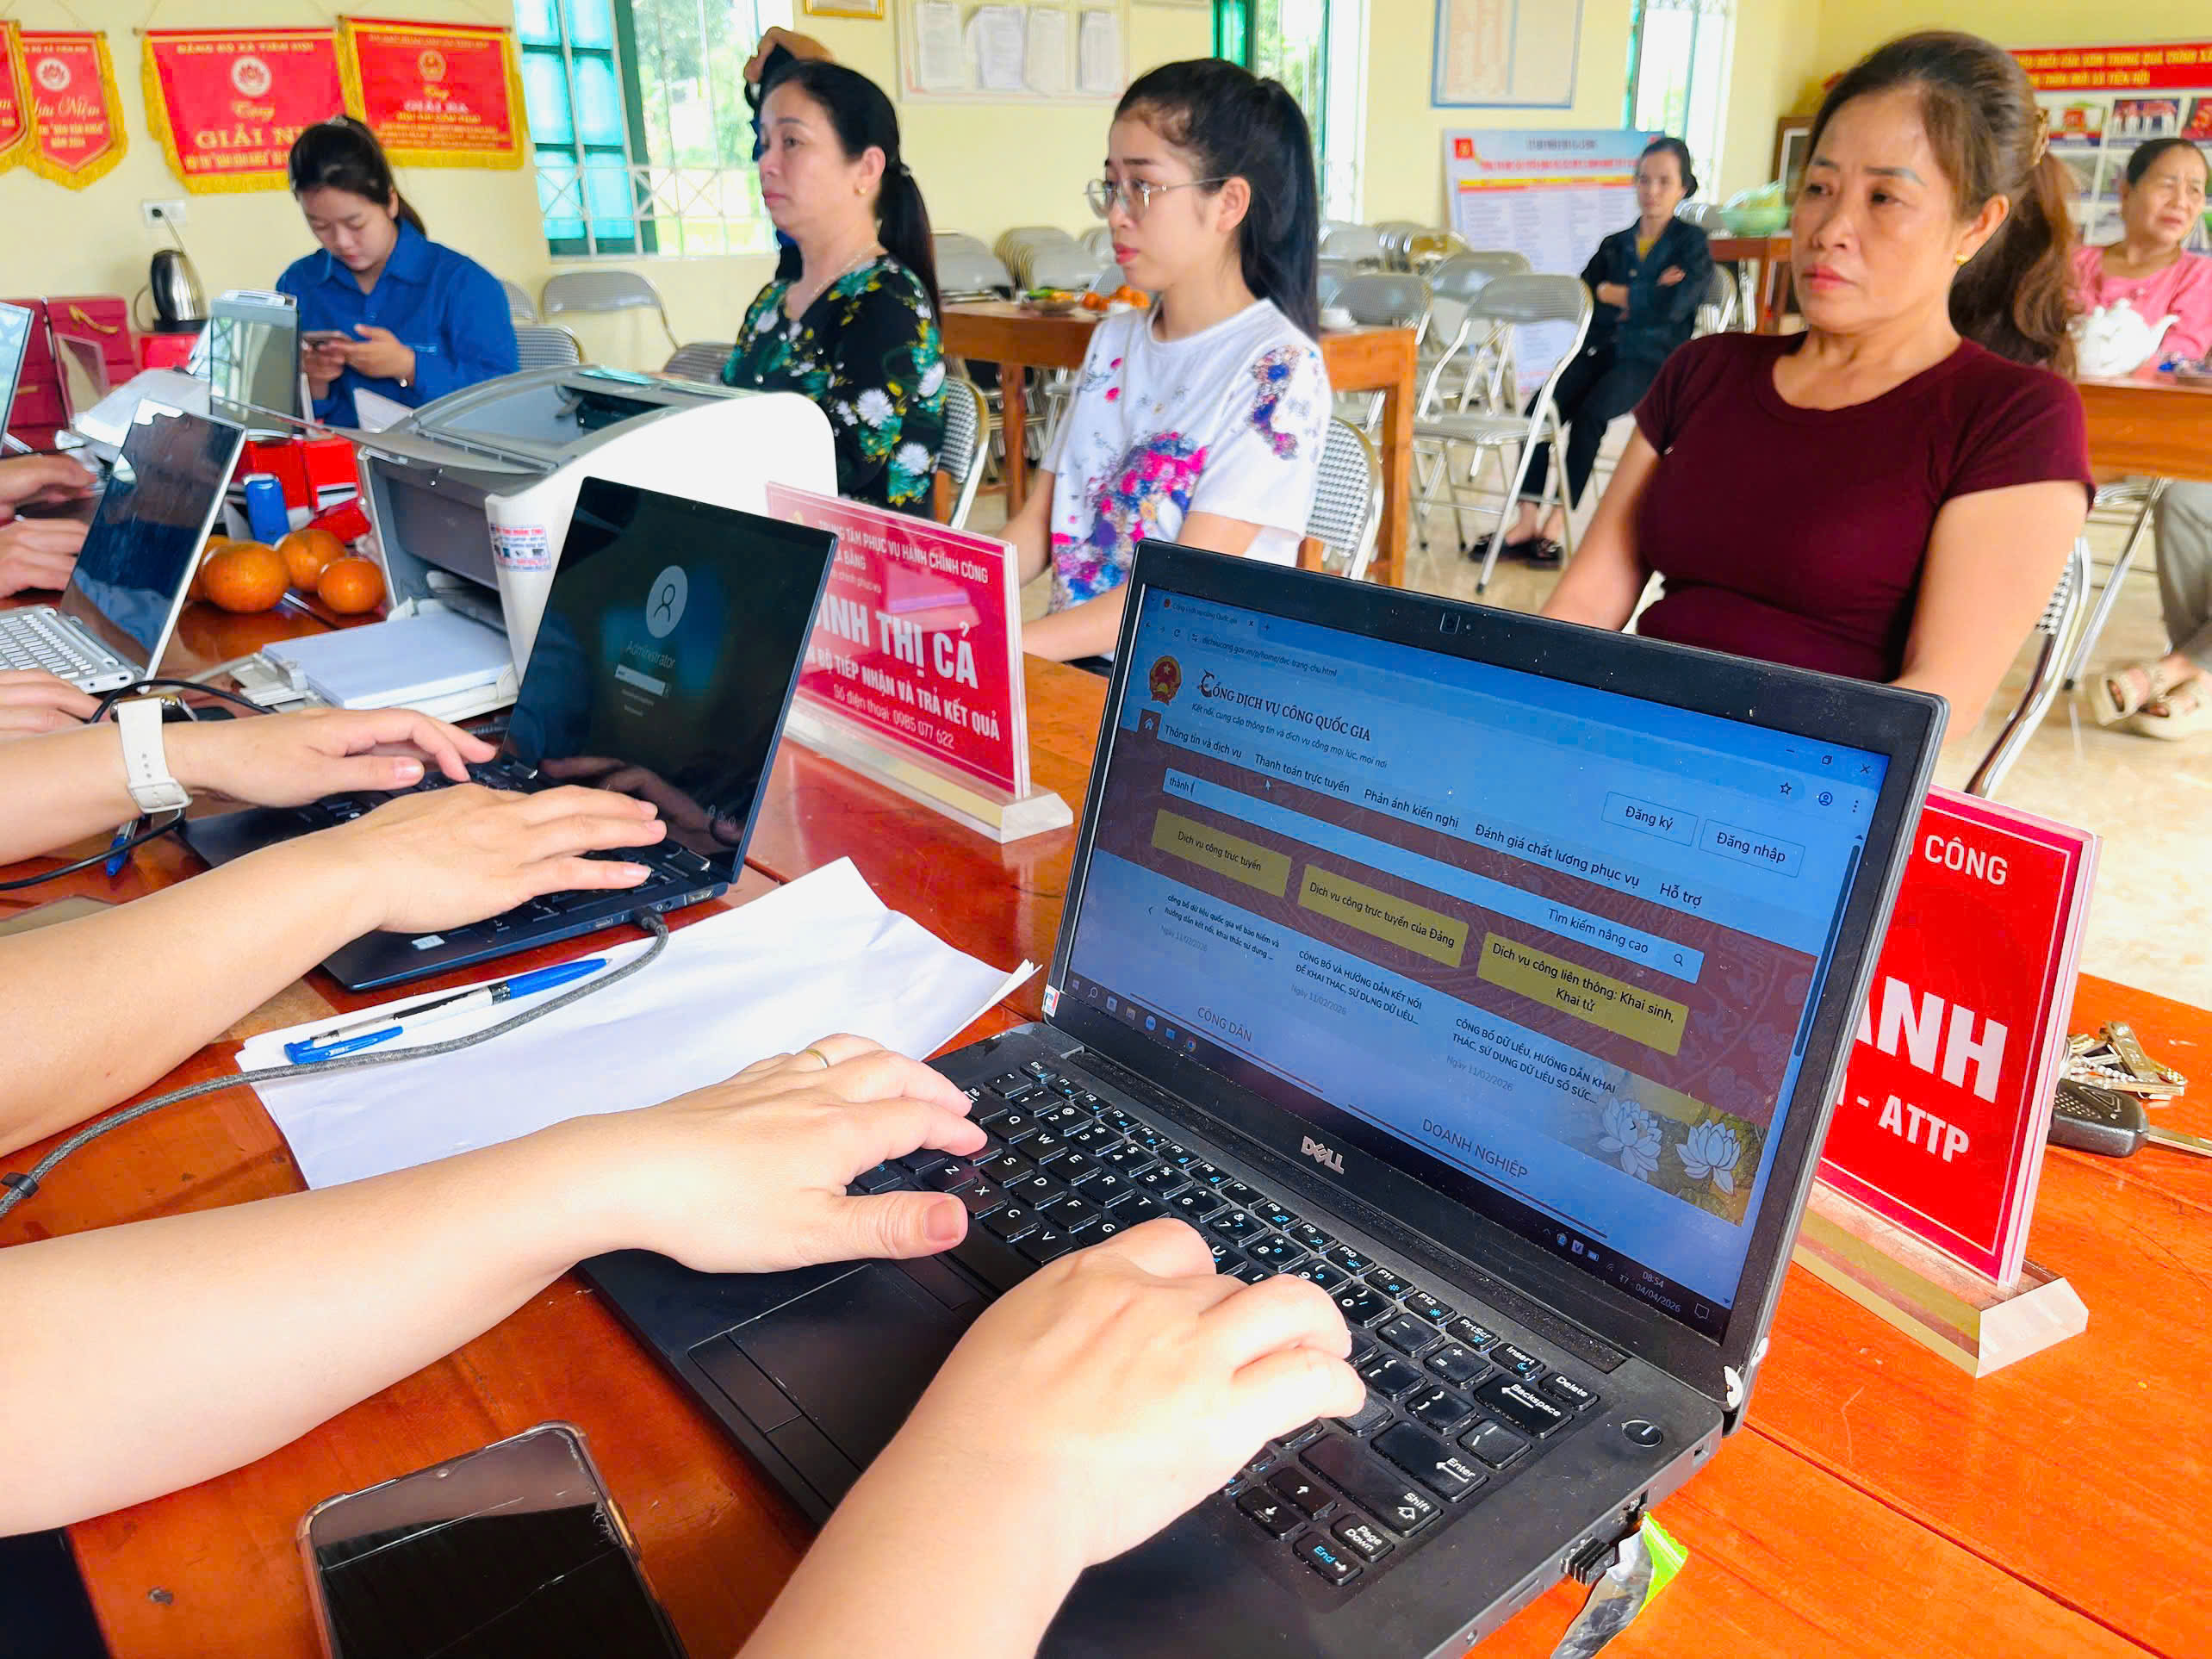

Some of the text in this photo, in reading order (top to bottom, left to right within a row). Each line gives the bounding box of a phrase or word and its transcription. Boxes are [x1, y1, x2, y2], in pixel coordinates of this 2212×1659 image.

[196, 123, 263, 149] GIẢI
[863, 533, 887, 555] PHỤC
[888, 540, 900, 560] VỤ
[903, 543, 927, 565] HÀNH
[929, 550, 960, 575] CHÍNH
[961, 560, 988, 584] CÔNG
[815, 594, 979, 689] INH THỊ CẢ
[818, 648, 833, 674] BỘ
[835, 654, 860, 681] TIẾP
[861, 666, 896, 697] NHẬN
[897, 680, 915, 705] VÀ
[916, 687, 941, 718] TRẢ
[944, 697, 968, 728] KẾT
[972, 710, 1000, 742] QUẢ
[1235, 692, 1264, 711] DỊCH
[1265, 700, 1281, 718] VỤ
[1282, 704, 1314, 724] CÔNG
[1314, 715, 1349, 735] QUỐC
[1350, 724, 1370, 742] GIA
[892, 710, 916, 732] 0985
[918, 721, 933, 740] 077
[937, 728, 955, 750] 622
[1190, 733, 1201, 745] tin
[1169, 777, 1190, 792] thành
[1255, 753, 1350, 793] Thanh toán trực tuyến
[1364, 788, 1460, 831] Phản ánh kiến nghị
[1625, 805, 1674, 831] Đăng ký
[1475, 823, 1640, 889] Đánh giá chất lượng phục vụ
[1717, 831, 1786, 864] Đăng nhập
[1925, 835, 2008, 885] CÔNG
[1659, 882, 1703, 910] Hỗ trợ
[1383, 910, 1409, 929] tuyến
[1410, 922, 1427, 936] của
[1429, 928, 1455, 949] Đảng
[1549, 908, 1649, 954] Tìm kiếm nâng cao
[1532, 960, 1558, 979] công
[1560, 969, 1580, 985] liên
[1619, 991, 1646, 1011] Khai
[1647, 1003, 1674, 1023] sinh,
[1556, 987, 1596, 1012] Khai tử
[1592, 1077, 1616, 1094] KHAI
[1141, 1127, 1153, 1135] F4
[1879, 1094, 1970, 1163] ATTP
[1171, 1145, 1184, 1154] F5
[1301, 1135, 1344, 1175] DELL
[1422, 1118, 1528, 1178] DOANH NGHIỆP
[1202, 1164, 1215, 1172] F6
[1267, 1202, 1281, 1212] F8
[1302, 1224, 1316, 1233] F9
[1339, 1246, 1357, 1258] F10
[1377, 1269, 1395, 1281] F11
[1642, 1271, 1665, 1289] 08:54
[1418, 1292, 1437, 1307] F12
[1635, 1283, 1681, 1314] 04/04/2026
[1460, 1318, 1492, 1339] PrtScr
[1506, 1345, 1536, 1366] Insert
[1556, 1376, 1589, 1398] Delete
[1510, 1383, 1562, 1417] Backspace
[1446, 1457, 1476, 1478] Enter
[1404, 1492, 1431, 1513] Shift
[1345, 1528, 1374, 1552] Down
[1358, 1525, 1382, 1546] Page
[1314, 1544, 1335, 1563] End
